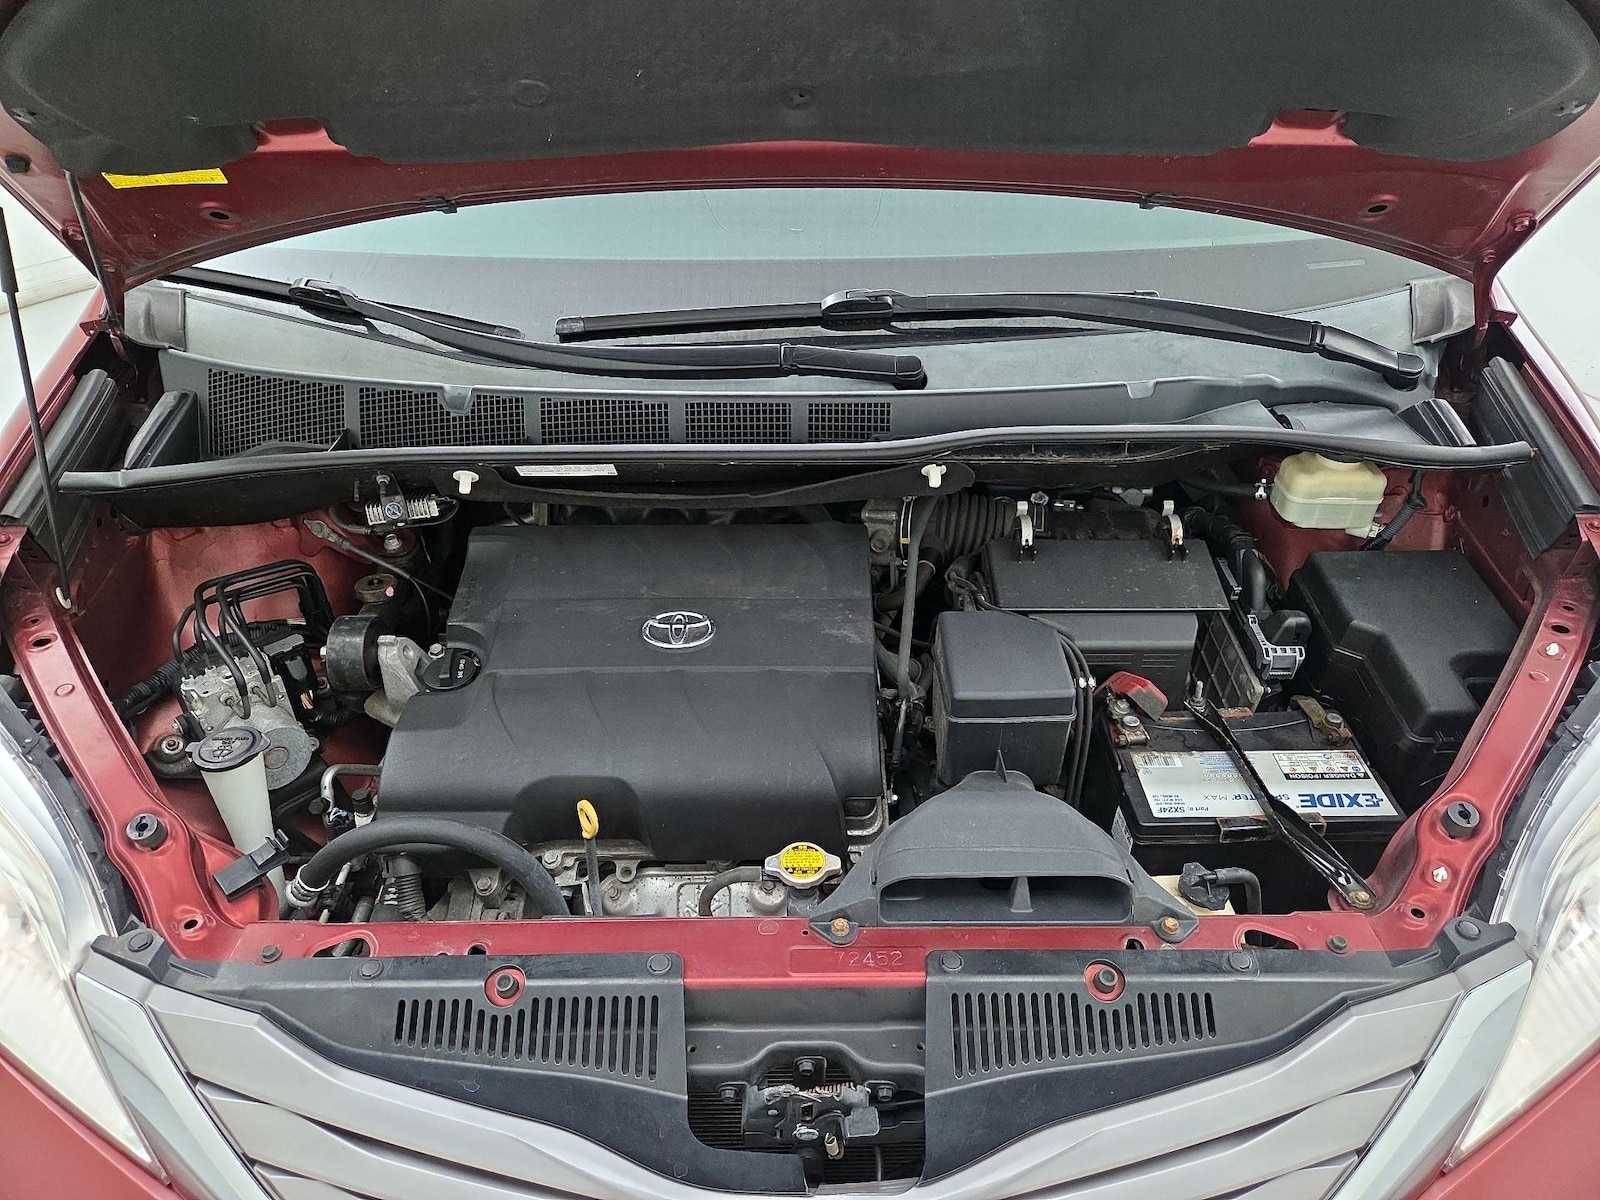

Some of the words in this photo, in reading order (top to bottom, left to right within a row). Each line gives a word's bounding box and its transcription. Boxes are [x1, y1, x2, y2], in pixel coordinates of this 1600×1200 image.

[1323, 772, 1356, 780] DANGER
[1297, 793, 1384, 808] EXIDE
[833, 950, 904, 967] 72452
